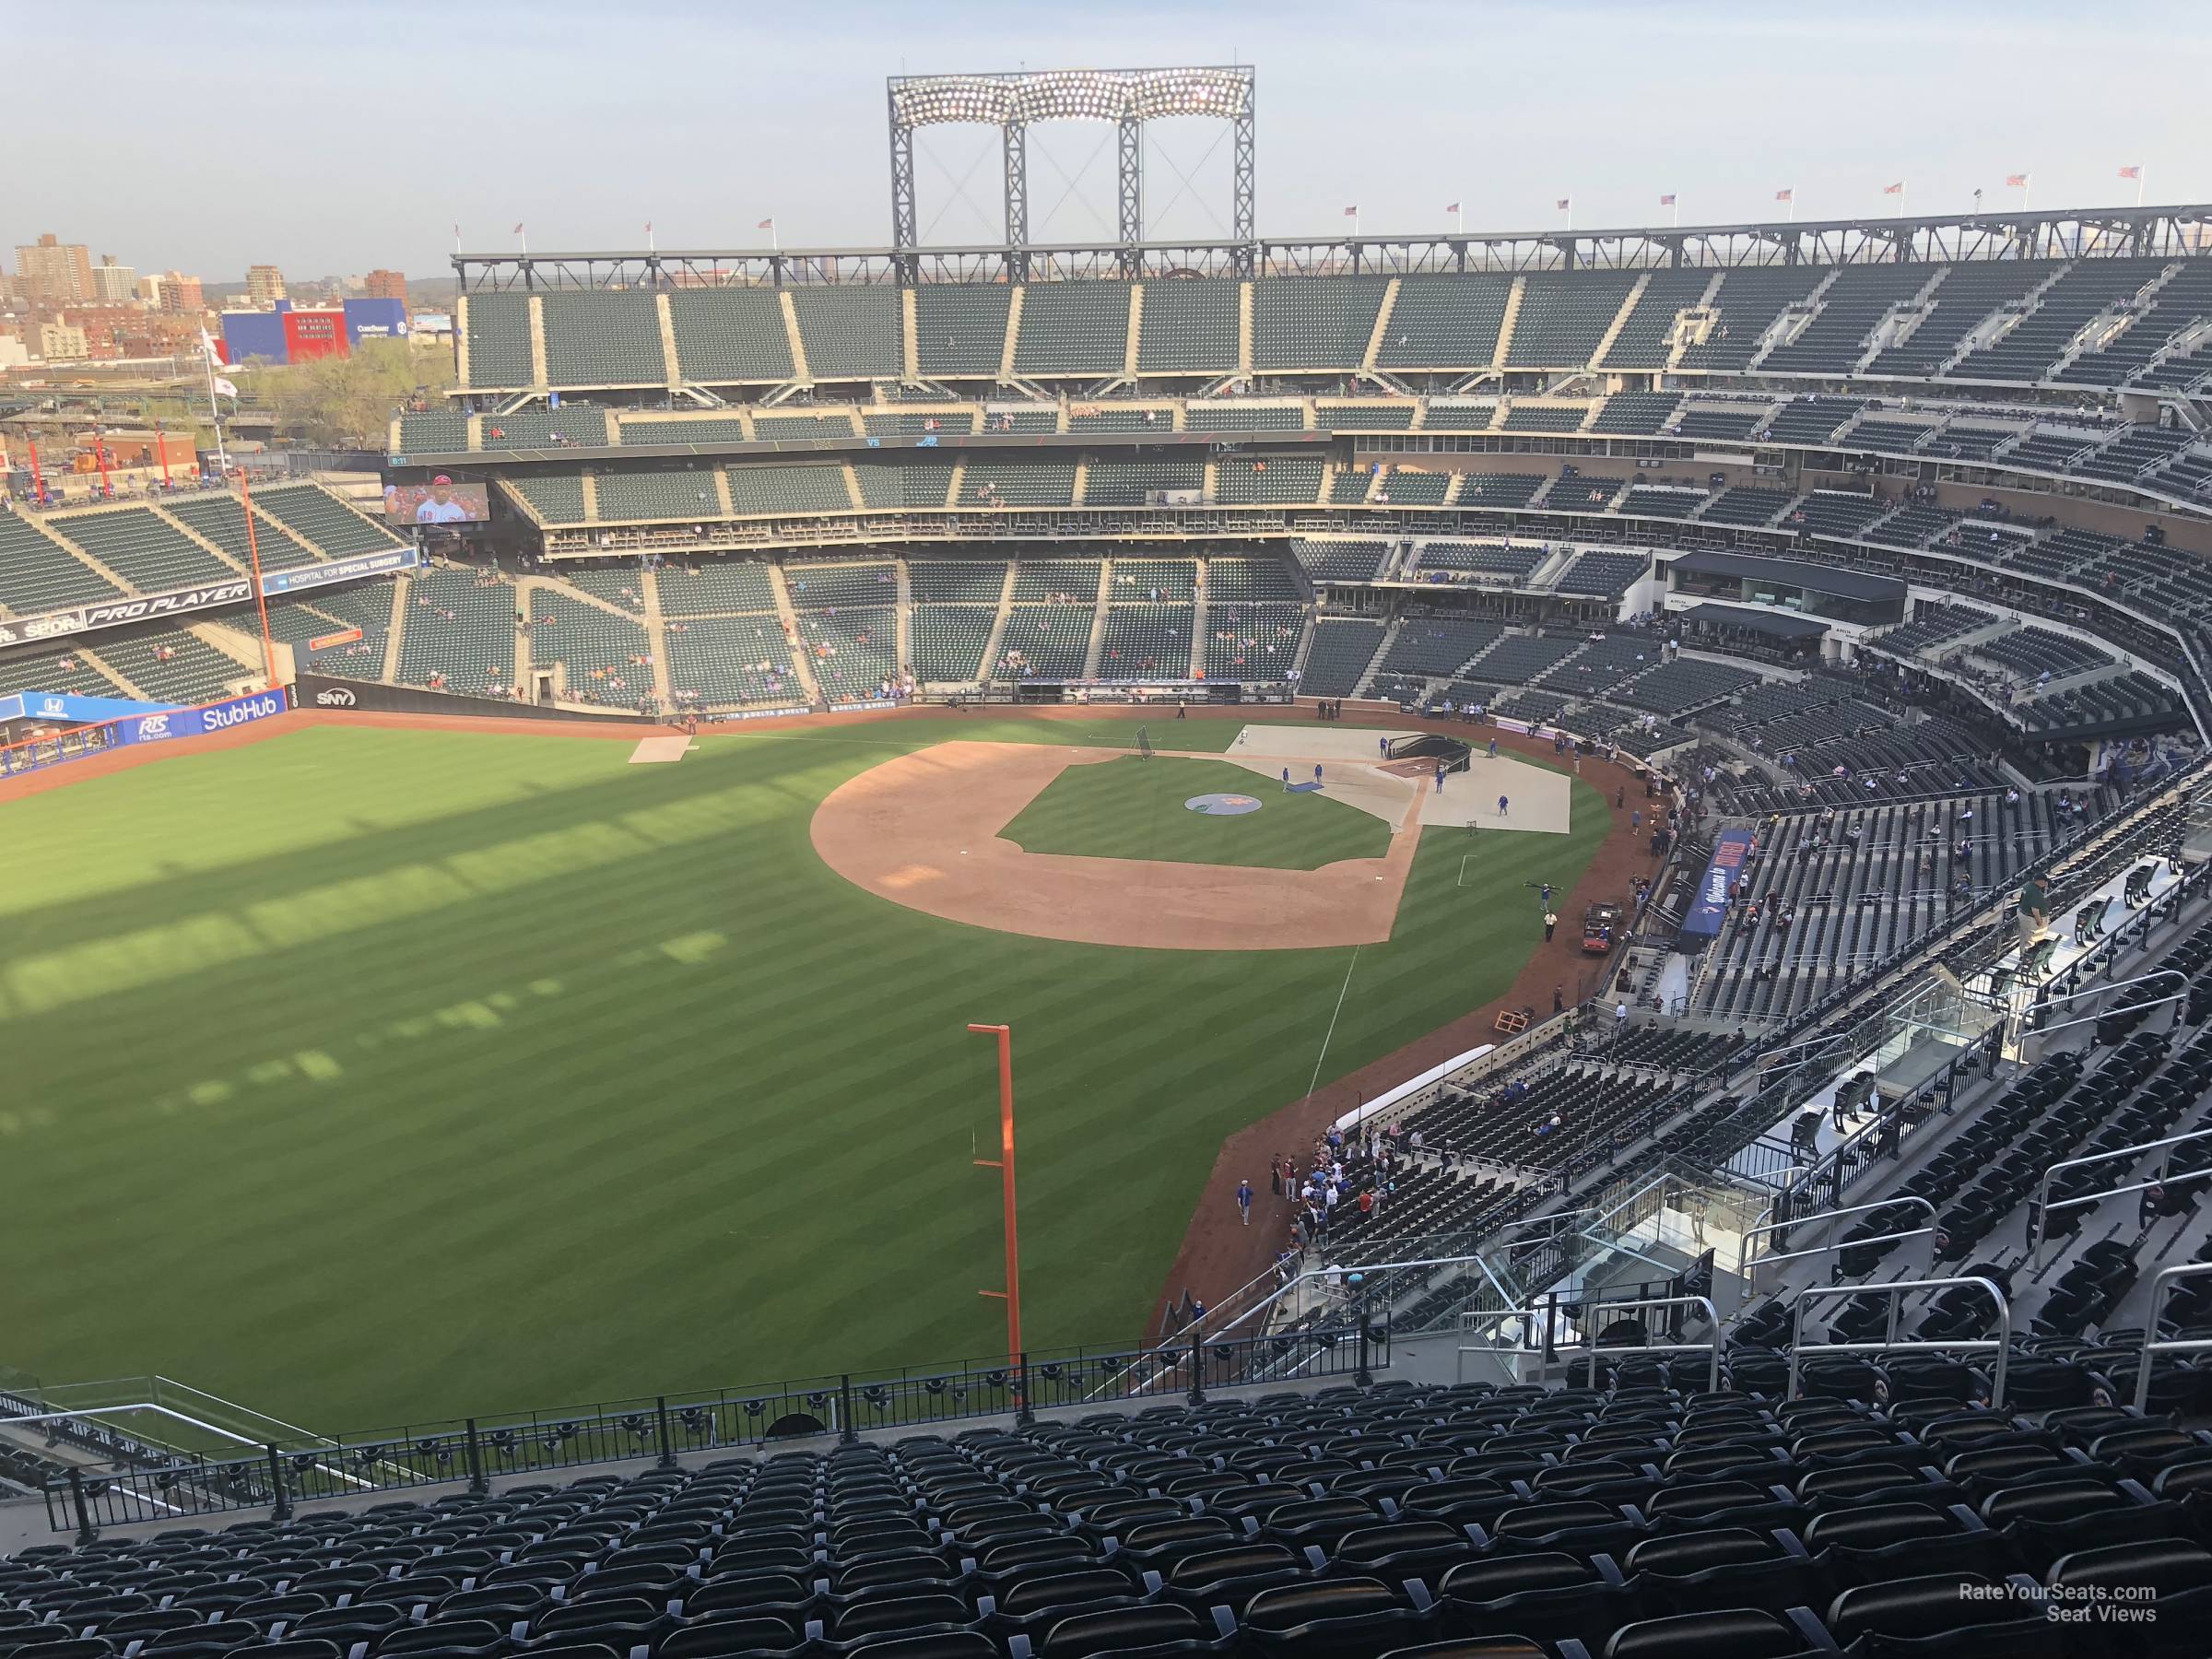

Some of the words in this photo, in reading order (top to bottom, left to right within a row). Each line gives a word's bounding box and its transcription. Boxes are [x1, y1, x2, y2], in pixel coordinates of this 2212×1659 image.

[288, 571, 323, 584] HOSPITAL
[324, 568, 338, 578] FOR
[339, 559, 369, 575] SPECIAL
[370, 555, 402, 570] SURGERY
[88, 602, 148, 624] PRO
[149, 583, 248, 613] PLAYER
[316, 690, 352, 706] SNY
[203, 696, 276, 730] StubHub
[138, 731, 172, 741] rts.com
[1705, 875, 1725, 903] Welcome
